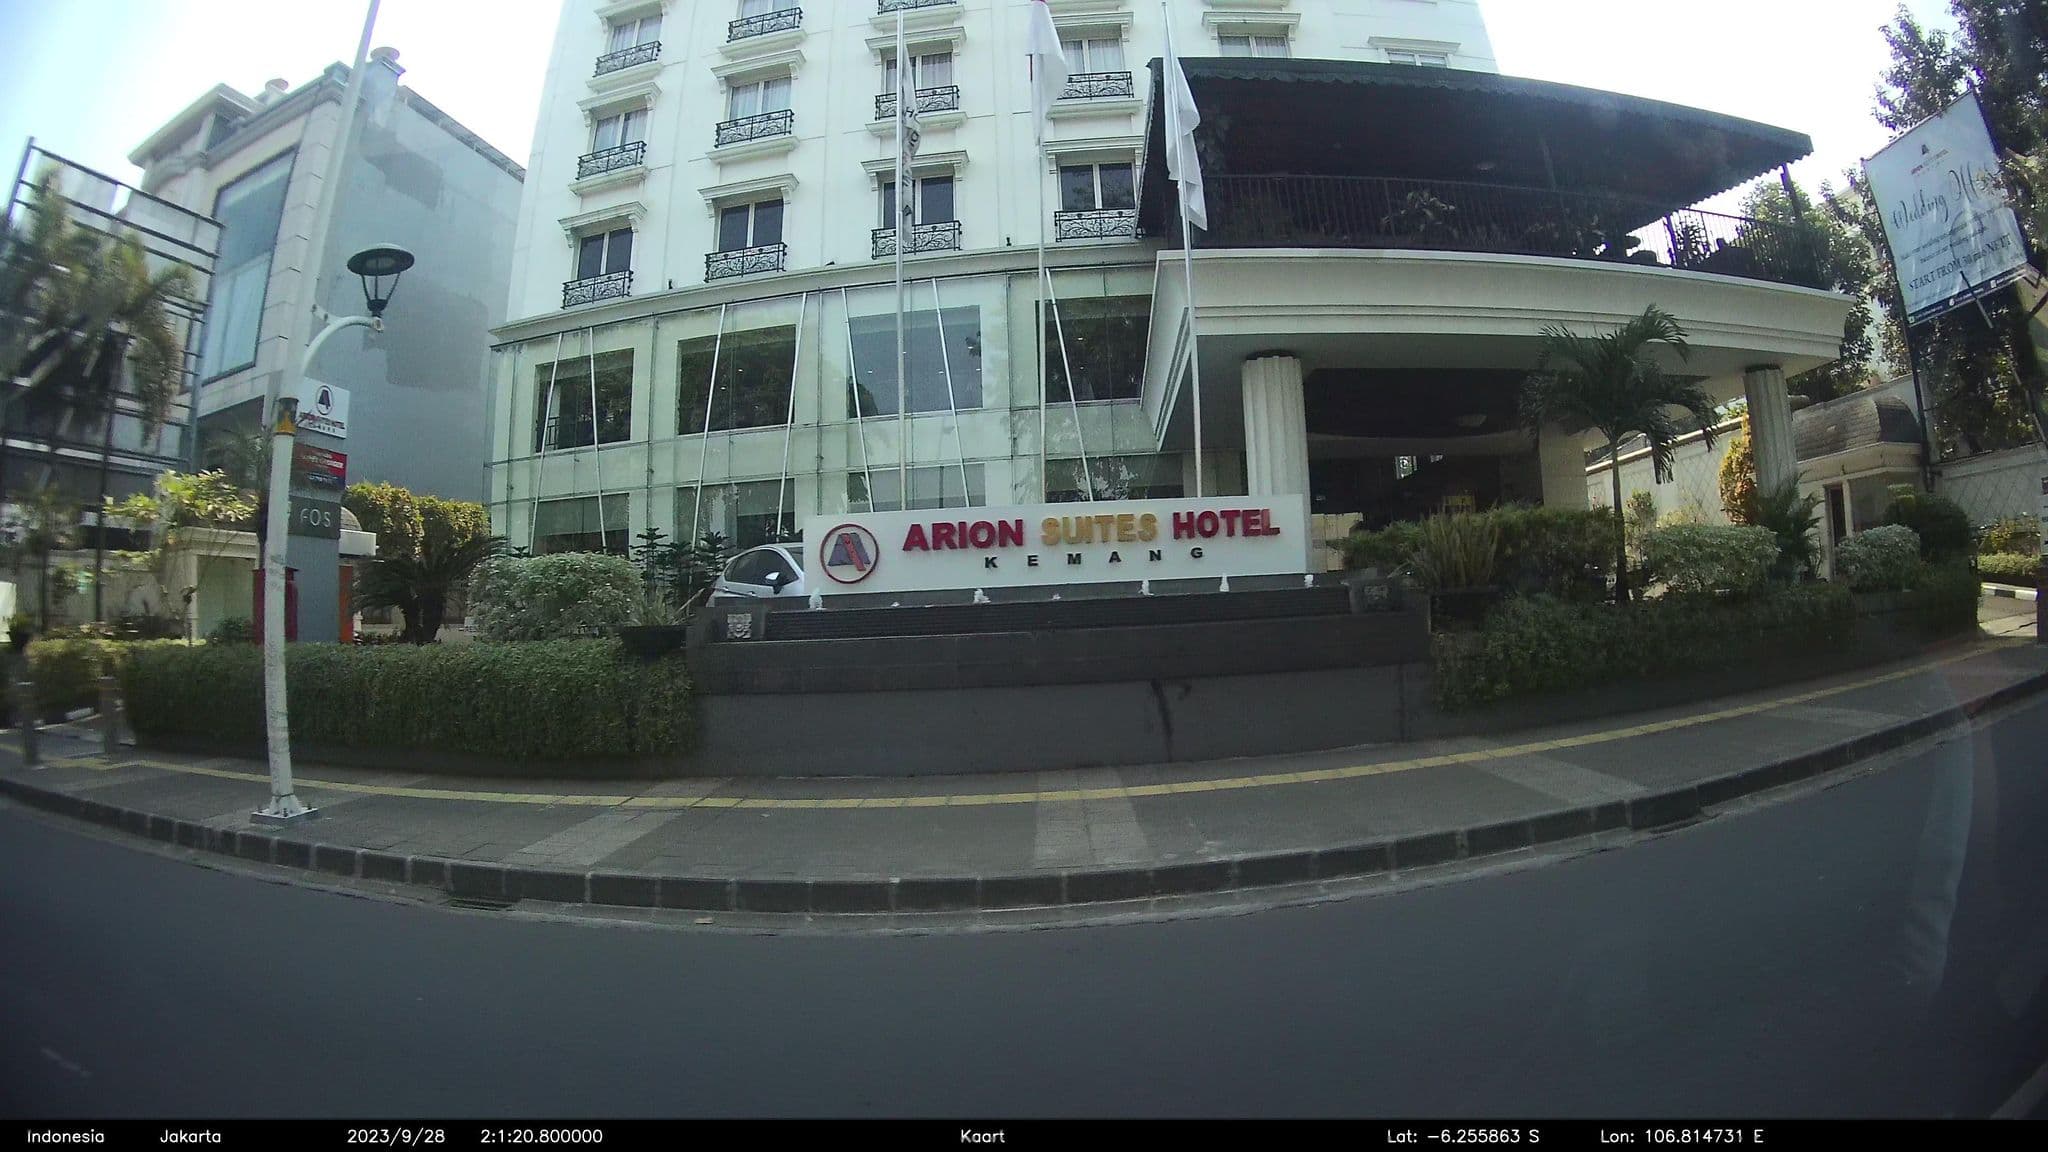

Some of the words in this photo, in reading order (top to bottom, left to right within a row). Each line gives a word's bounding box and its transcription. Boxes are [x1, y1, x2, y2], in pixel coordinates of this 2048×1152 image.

[1908, 270, 1936, 290] START
[903, 518, 1024, 551] ARION
[1041, 513, 1158, 545] SUITES
[1173, 508, 1281, 539] HOTEL
[985, 547, 1204, 569] KEMANG
